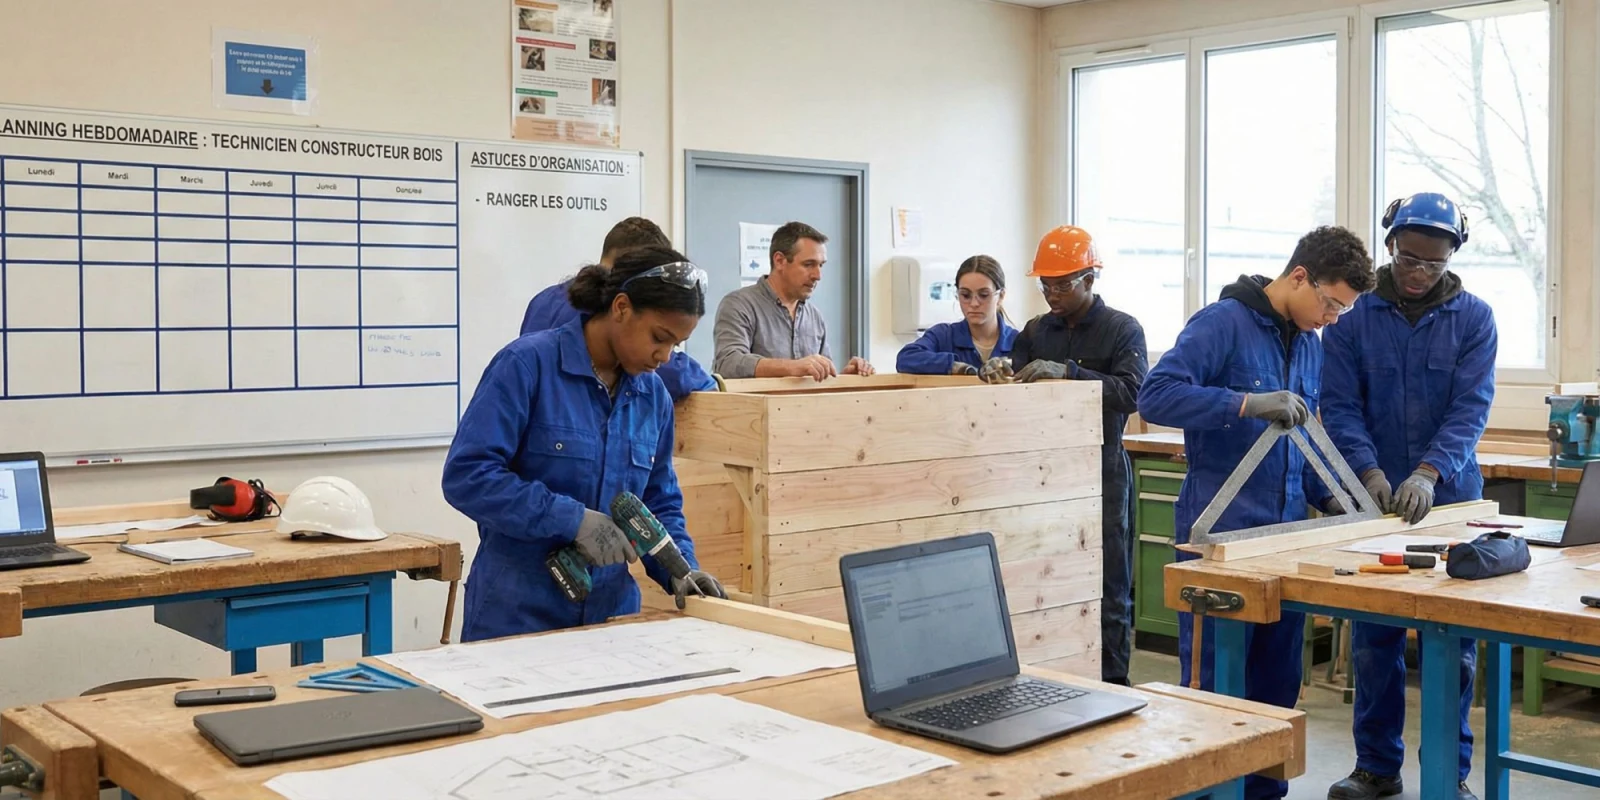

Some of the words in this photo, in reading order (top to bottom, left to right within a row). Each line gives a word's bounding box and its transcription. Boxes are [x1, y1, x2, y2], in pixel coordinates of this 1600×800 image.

[0, 119, 67, 137] ANNING
[72, 123, 198, 146] HEBDOMADAIRE
[211, 133, 297, 152] TECHNICIEN
[301, 139, 410, 160] CONSTRUCTEUR
[413, 148, 443, 162] BOIS
[471, 151, 526, 167] ASTUCES
[529, 155, 624, 174] D'ORGANISATION
[486, 192, 538, 208] RANGER
[541, 195, 563, 209] LES
[567, 196, 608, 211] OUTILS
